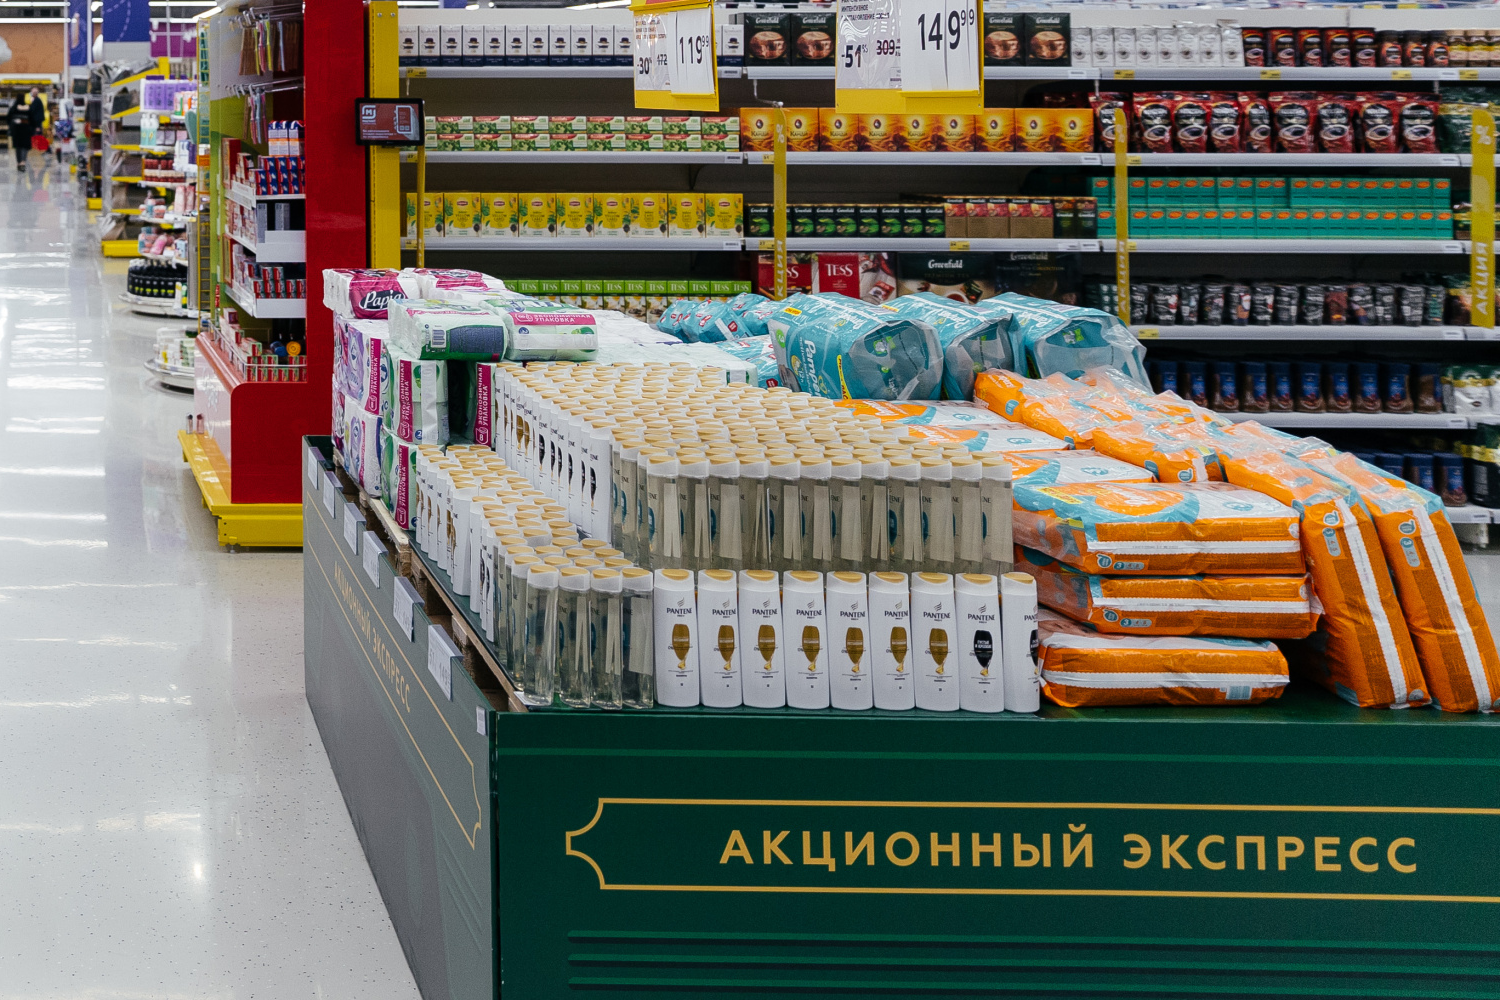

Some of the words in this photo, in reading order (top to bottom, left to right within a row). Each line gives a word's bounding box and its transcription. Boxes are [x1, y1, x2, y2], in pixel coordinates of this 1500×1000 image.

[918, 10, 961, 51] 149
[679, 35, 703, 65] 119
[928, 259, 963, 269] Greenfield
[786, 265, 799, 279] SS
[825, 263, 853, 277] TESS
[1475, 241, 1489, 316] АКЦИЯ
[521, 283, 537, 291] TESS
[542, 283, 558, 291] TESS
[584, 283, 601, 291] TESS
[606, 283, 622, 291] TESS
[627, 283, 643, 291] TESS
[671, 283, 686, 291] TESS
[713, 283, 729, 291] TESS
[733, 283, 749, 291] TESS
[362, 290, 403, 308] Papia
[666, 607, 692, 615] PANTENE
[712, 608, 736, 616] PANTENE
[839, 610, 865, 618] PANTENE
[923, 611, 950, 619] PANTENE
[968, 613, 995, 621] PANTENE
[372, 627, 411, 713] ЭКСПРЕСС
[719, 823, 1095, 873] АКЦИОННЫЙ
[1123, 832, 1418, 874] ЭКСПРЕСС
